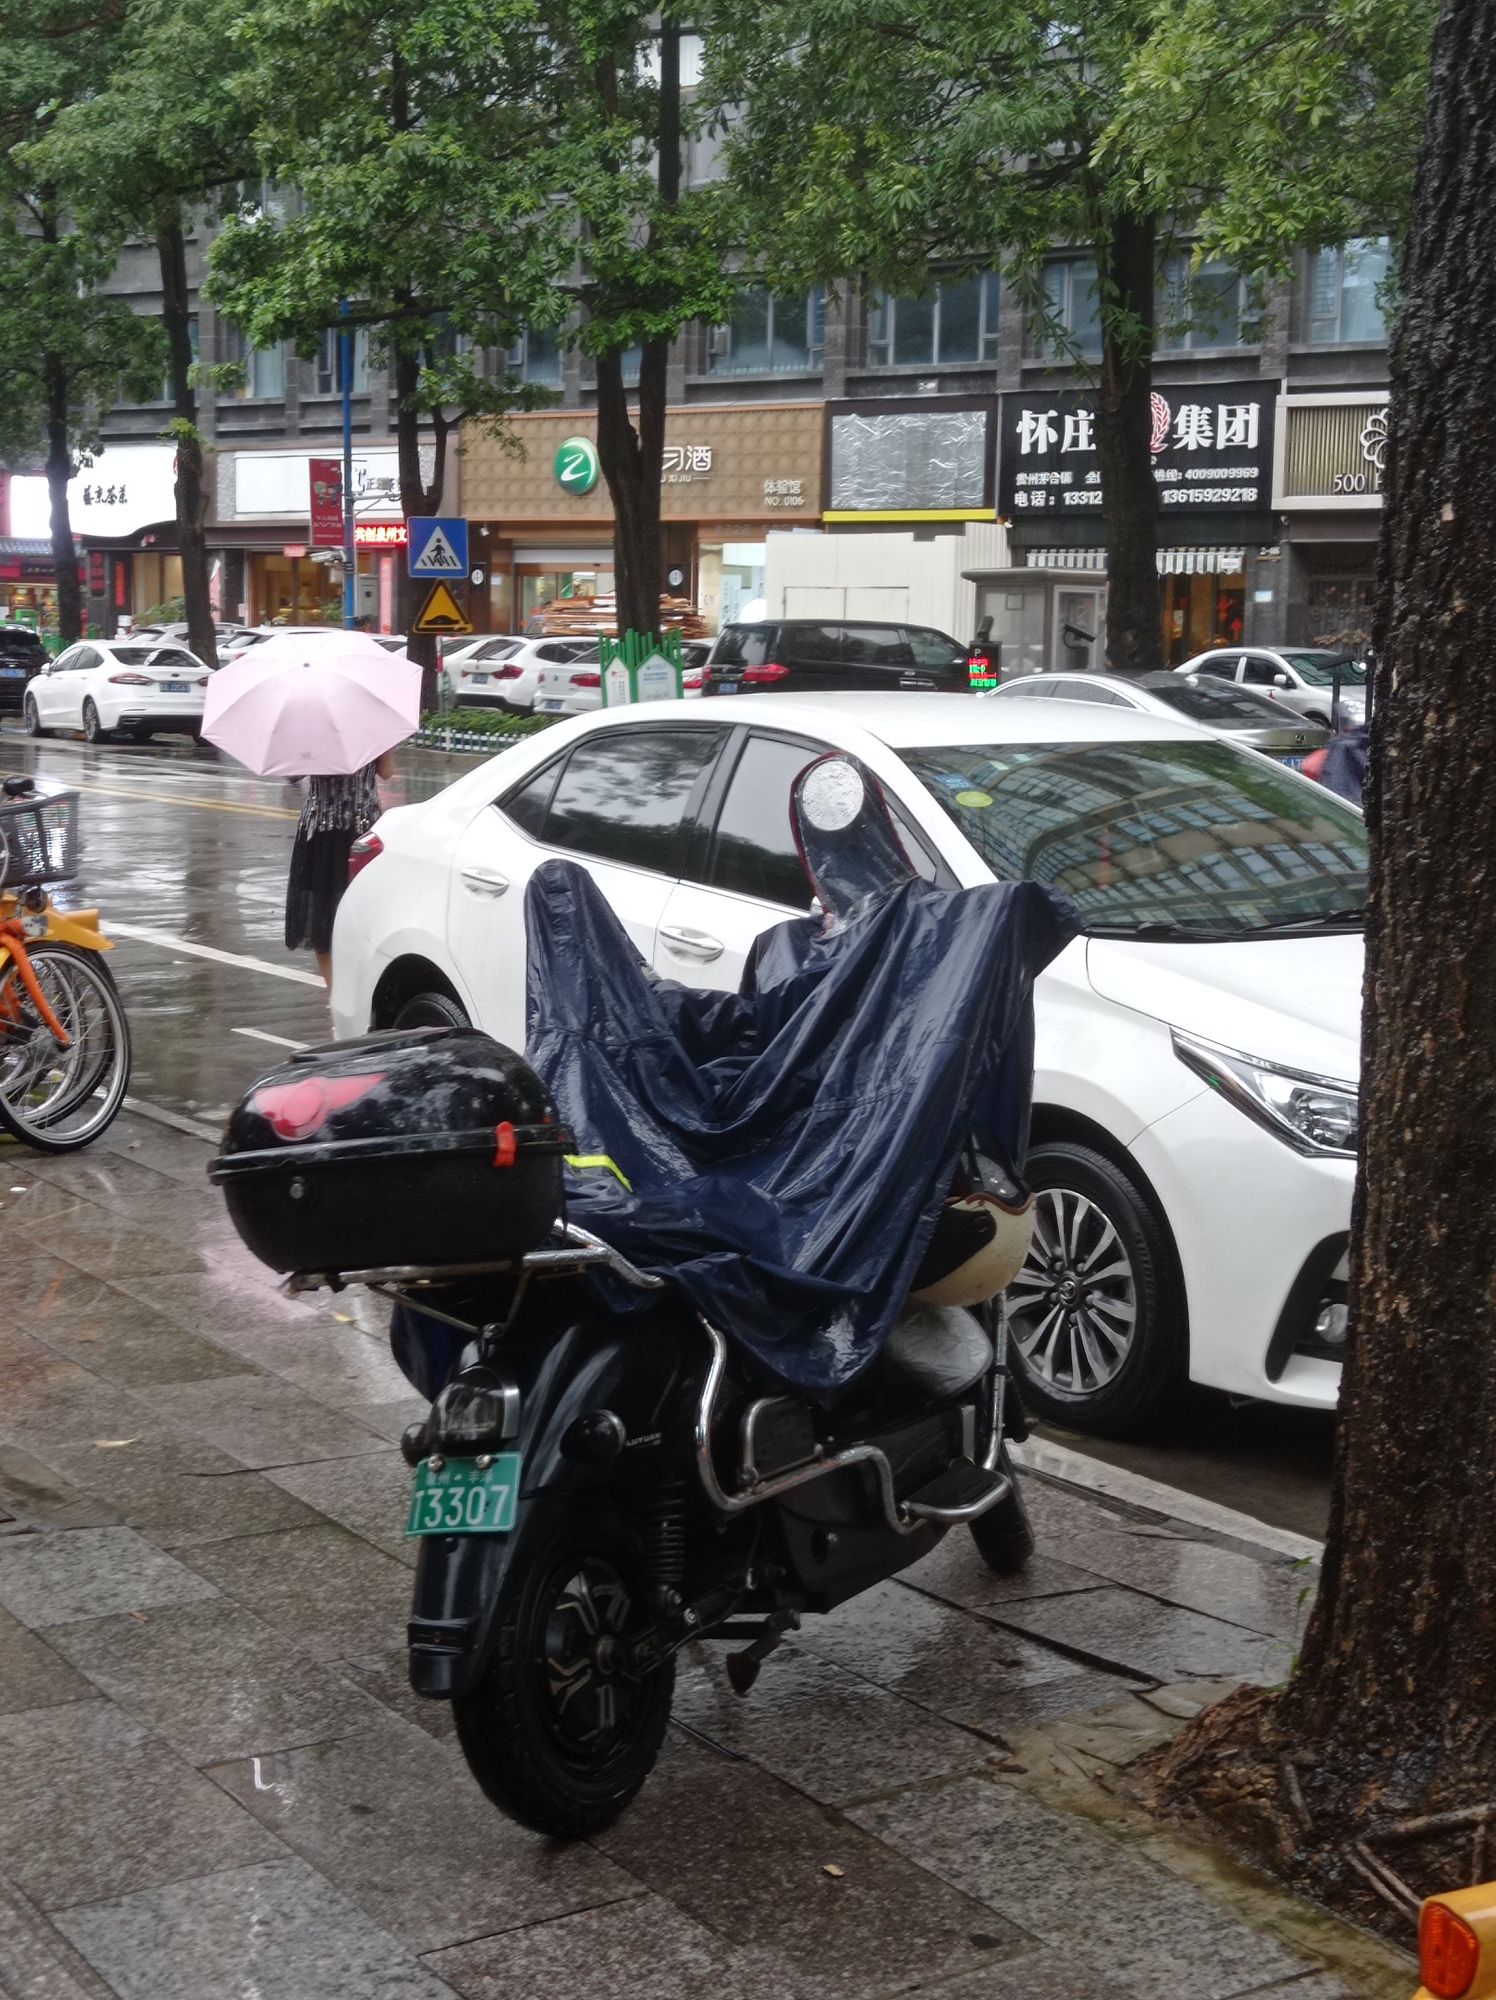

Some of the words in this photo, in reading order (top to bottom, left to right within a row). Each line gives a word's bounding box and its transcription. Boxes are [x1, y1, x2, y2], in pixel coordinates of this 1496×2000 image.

[1016, 409, 1097, 455] 怀庄
[1172, 402, 1260, 451] 集团
[662, 445, 712, 471] 习酒
[1084, 470, 1101, 484] 全
[1334, 473, 1365, 492] 500
[764, 480, 802, 495] 体验馆
[1062, 490, 1104, 506] 13312
[1161, 487, 1259, 505] 13615929218
[784, 496, 805, 506] 0106
[411, 1485, 511, 1531] 13307
